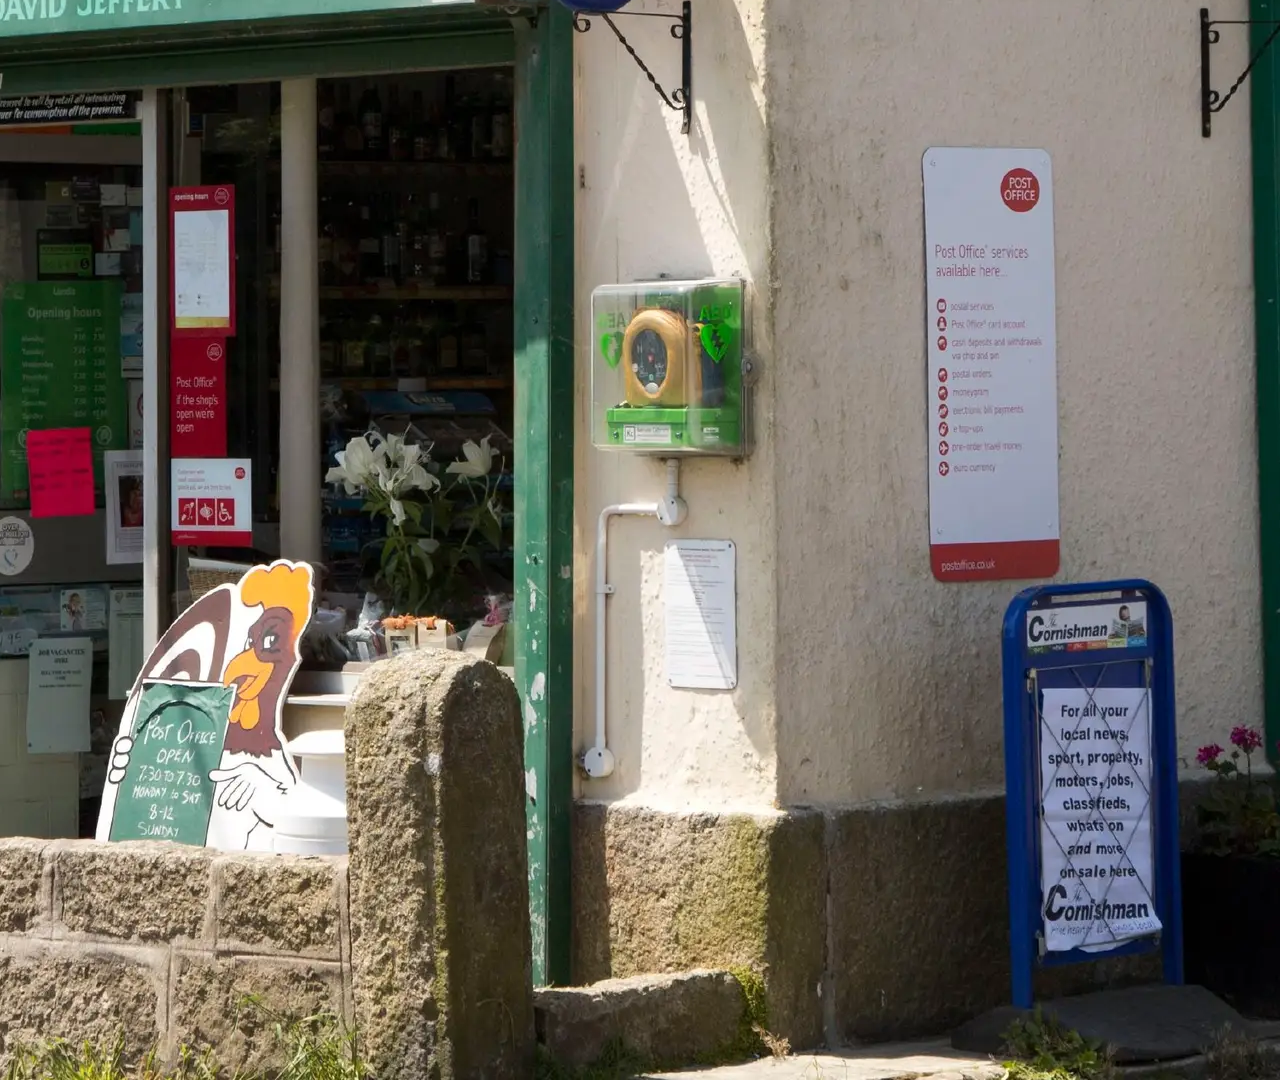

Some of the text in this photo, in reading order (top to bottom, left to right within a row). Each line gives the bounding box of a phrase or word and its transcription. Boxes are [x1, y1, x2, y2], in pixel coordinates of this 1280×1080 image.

[1009, 177, 1032, 189] POST
[1004, 189, 1035, 201] OFFICE
[935, 244, 956, 259] Post
[991, 246, 1029, 259] services
[936, 264, 976, 277] available
[28, 306, 101, 320] Opening hours
[176, 376, 191, 388] Post
[183, 394, 194, 405] the
[176, 410, 194, 421] open
[994, 406, 1024, 416] payments
[176, 424, 194, 434] open
[941, 558, 996, 572] postoffice.co.uk
[1029, 615, 1108, 642] Cornishman
[1061, 704, 1128, 720] For all your
[1061, 728, 1129, 742] local news,
[156, 748, 195, 764] OPEN
[1048, 751, 1143, 766] sport, property,
[176, 771, 201, 787] 7.30
[1107, 774, 1133, 789] jobs,
[132, 785, 167, 799] MONDAY
[1063, 796, 1130, 811] classifieds,
[137, 822, 179, 837] SUNDAY
[1067, 820, 1124, 831] whats on
[1068, 841, 1123, 855] and more
[1060, 864, 1136, 878] on sale here
[1046, 884, 1149, 921] Cornishman
